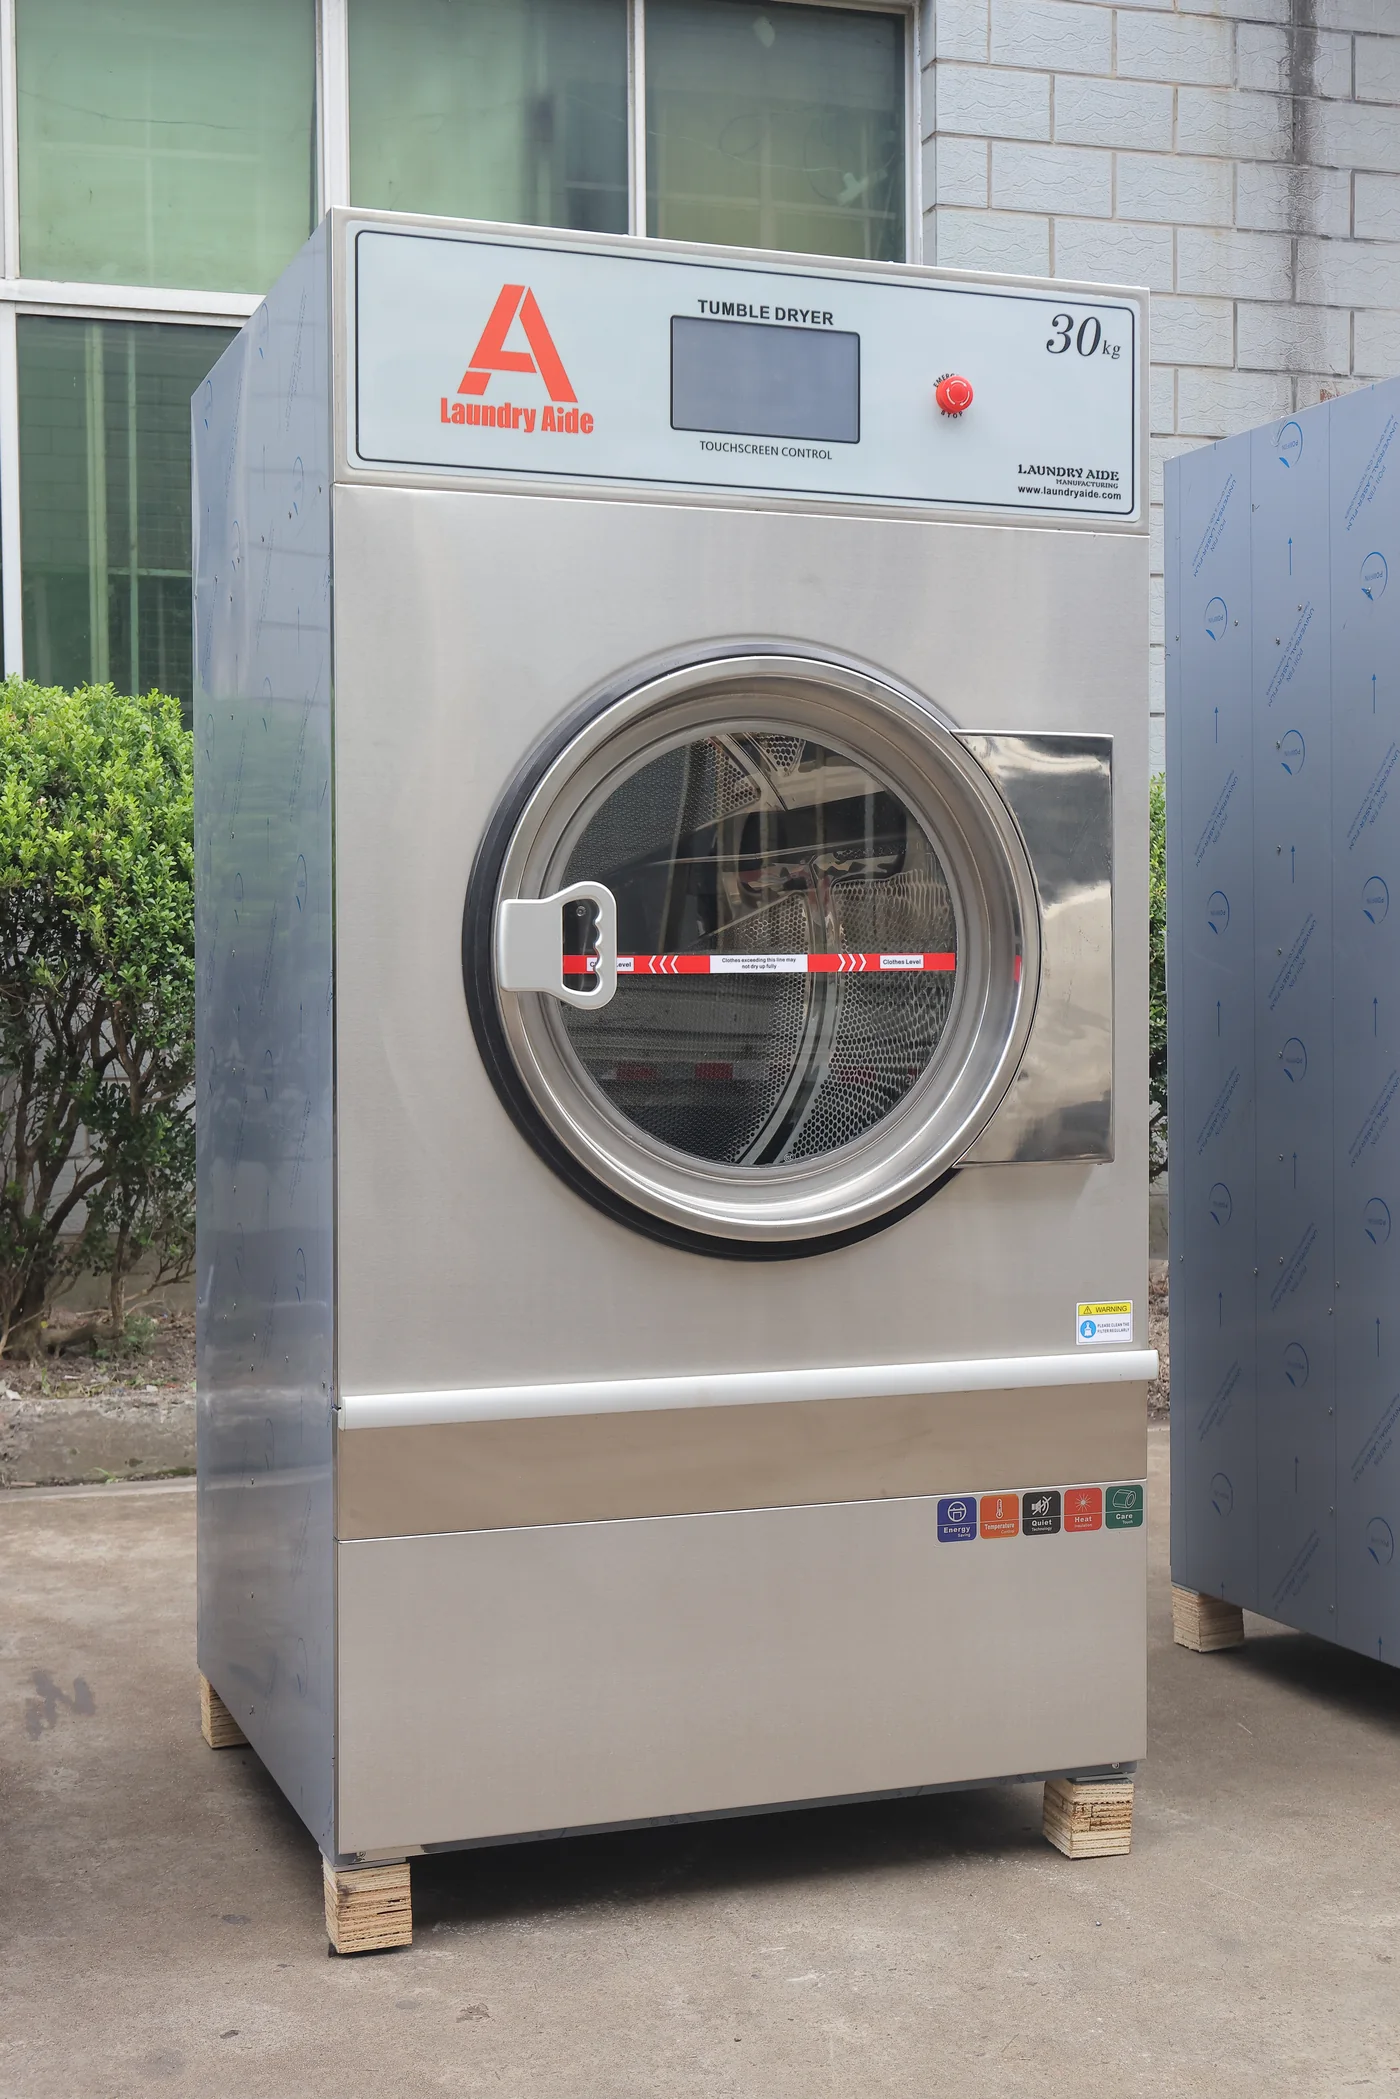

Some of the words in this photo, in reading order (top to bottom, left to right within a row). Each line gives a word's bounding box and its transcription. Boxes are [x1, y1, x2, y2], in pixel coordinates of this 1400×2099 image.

[698, 299, 770, 319] TUMBLE
[775, 307, 834, 325] DRYER
[441, 398, 536, 433] Laundry
[541, 406, 594, 434] Aide
[700, 441, 778, 456] TOUCHSCREEN
[782, 446, 832, 460] CONTROL
[1371, 422, 1398, 473] UNIVERSAL
[1018, 464, 1083, 478] LAUNDRY
[1086, 470, 1119, 481] AIDE
[1018, 486, 1121, 500] www.laundryaide.com
[1056, 479, 1118, 489] MANUFACTURING
[1214, 480, 1236, 525] UNIVERSAL
[1346, 475, 1373, 531] LASER-FILM
[1193, 527, 1216, 577] LASER-FILM
[1290, 608, 1314, 654] UNIVERSAL
[1267, 657, 1292, 707] LASER-FILM
[1374, 750, 1399, 797] UNIVERSAL
[1216, 776, 1238, 818] UNIVERSAL
[1196, 820, 1217, 867] LASER-FILM
[1349, 798, 1375, 850] LASER-FILM
[1292, 920, 1316, 962] UNIVERSAL
[1270, 964, 1295, 1011] LASER-FILM
[944, 1526, 970, 1534] Energy
